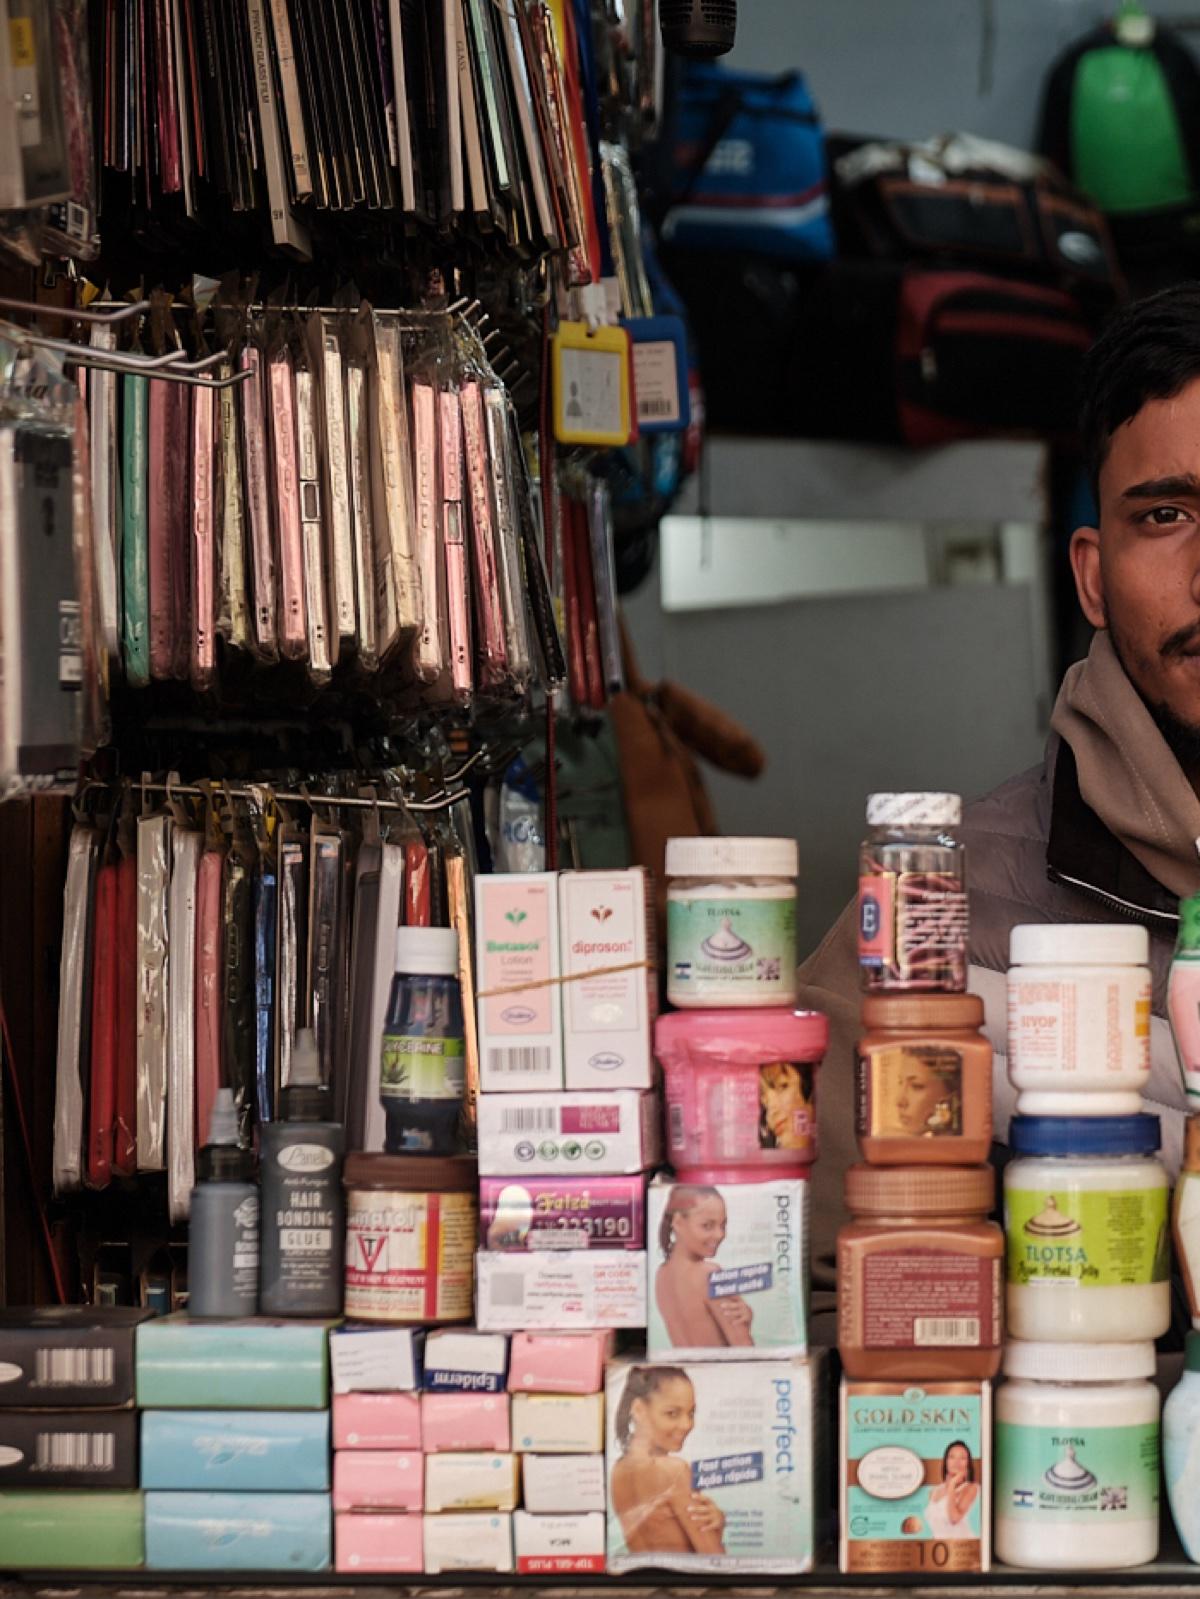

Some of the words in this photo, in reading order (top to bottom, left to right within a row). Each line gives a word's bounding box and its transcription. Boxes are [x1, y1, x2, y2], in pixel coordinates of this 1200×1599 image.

[486, 940, 540, 953] Betasol
[500, 955, 533, 966] Lotion
[290, 1190, 323, 1208] HAIR
[276, 1210, 334, 1227] BONDING
[286, 1232, 323, 1246] GLUE
[773, 1194, 793, 1274] perfect
[1025, 1244, 1088, 1263] TLOTSA
[432, 1371, 497, 1390] Epiderm
[853, 1407, 915, 1426] GOLD
[919, 1407, 973, 1426] SKIN
[771, 1378, 797, 1474] perfect
[1051, 1436, 1086, 1447] TLOTSA
[697, 1458, 720, 1473] Fast
[721, 1455, 753, 1470] action
[917, 1541, 950, 1567] 10
[527, 1558, 554, 1570] PLUS
[555, 1558, 595, 1570] TOP-GEL
